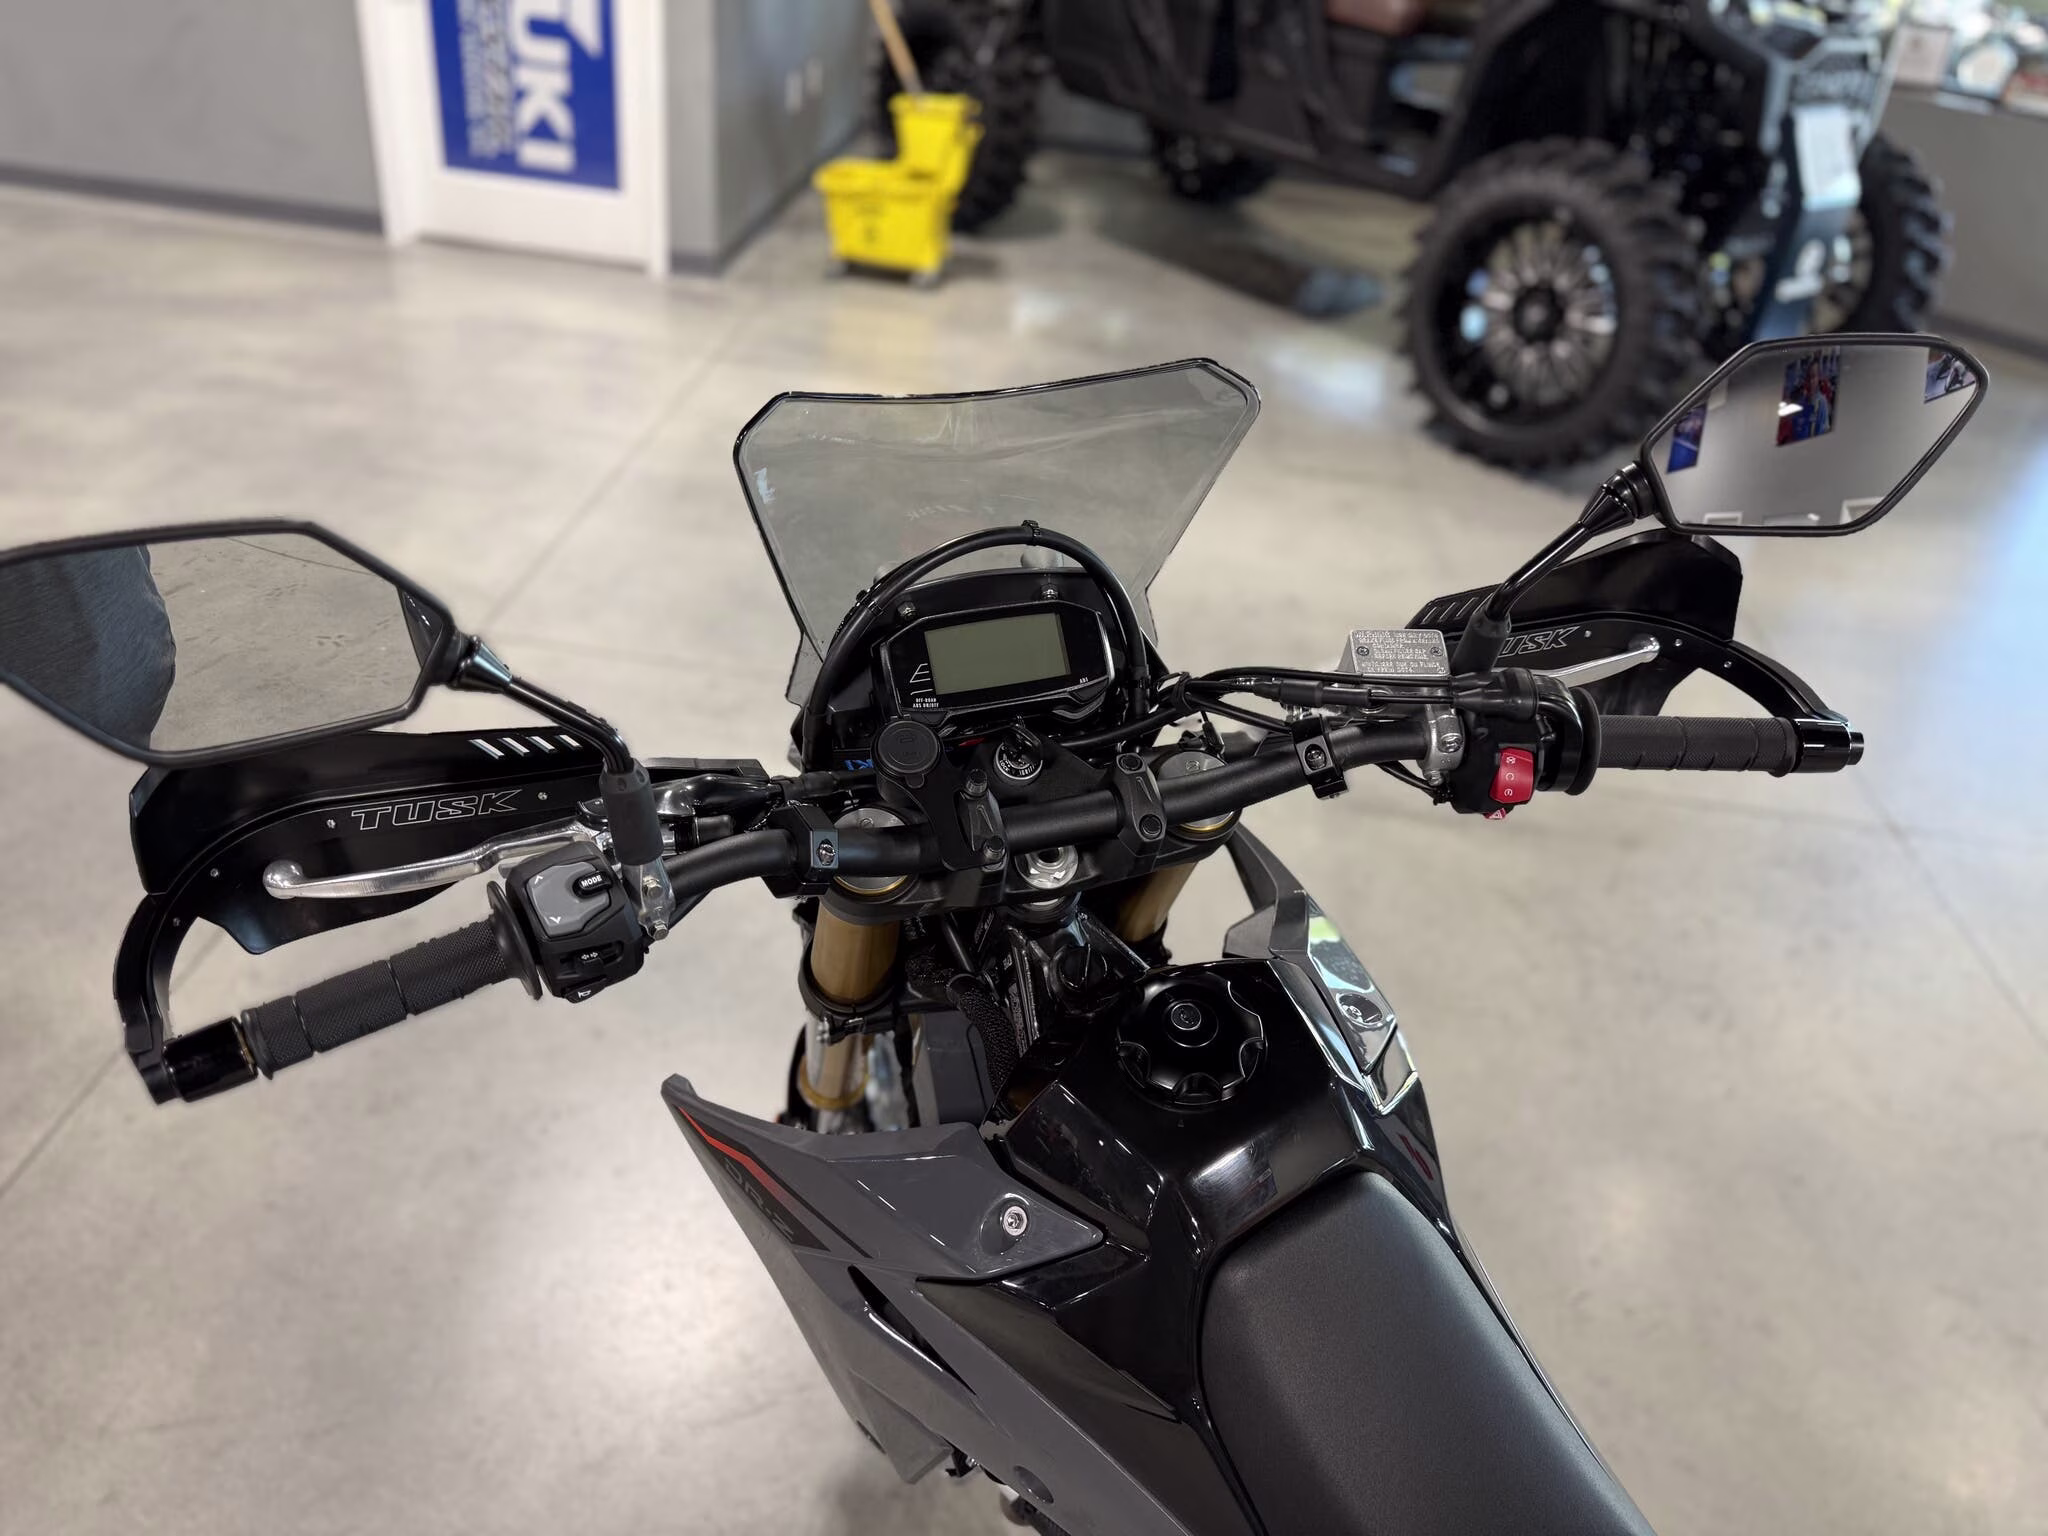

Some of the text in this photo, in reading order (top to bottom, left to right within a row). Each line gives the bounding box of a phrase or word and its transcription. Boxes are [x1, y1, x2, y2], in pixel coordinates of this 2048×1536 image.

[1497, 625, 1581, 659] USK
[351, 789, 523, 831] TUSK
[581, 874, 602, 889] MODE
